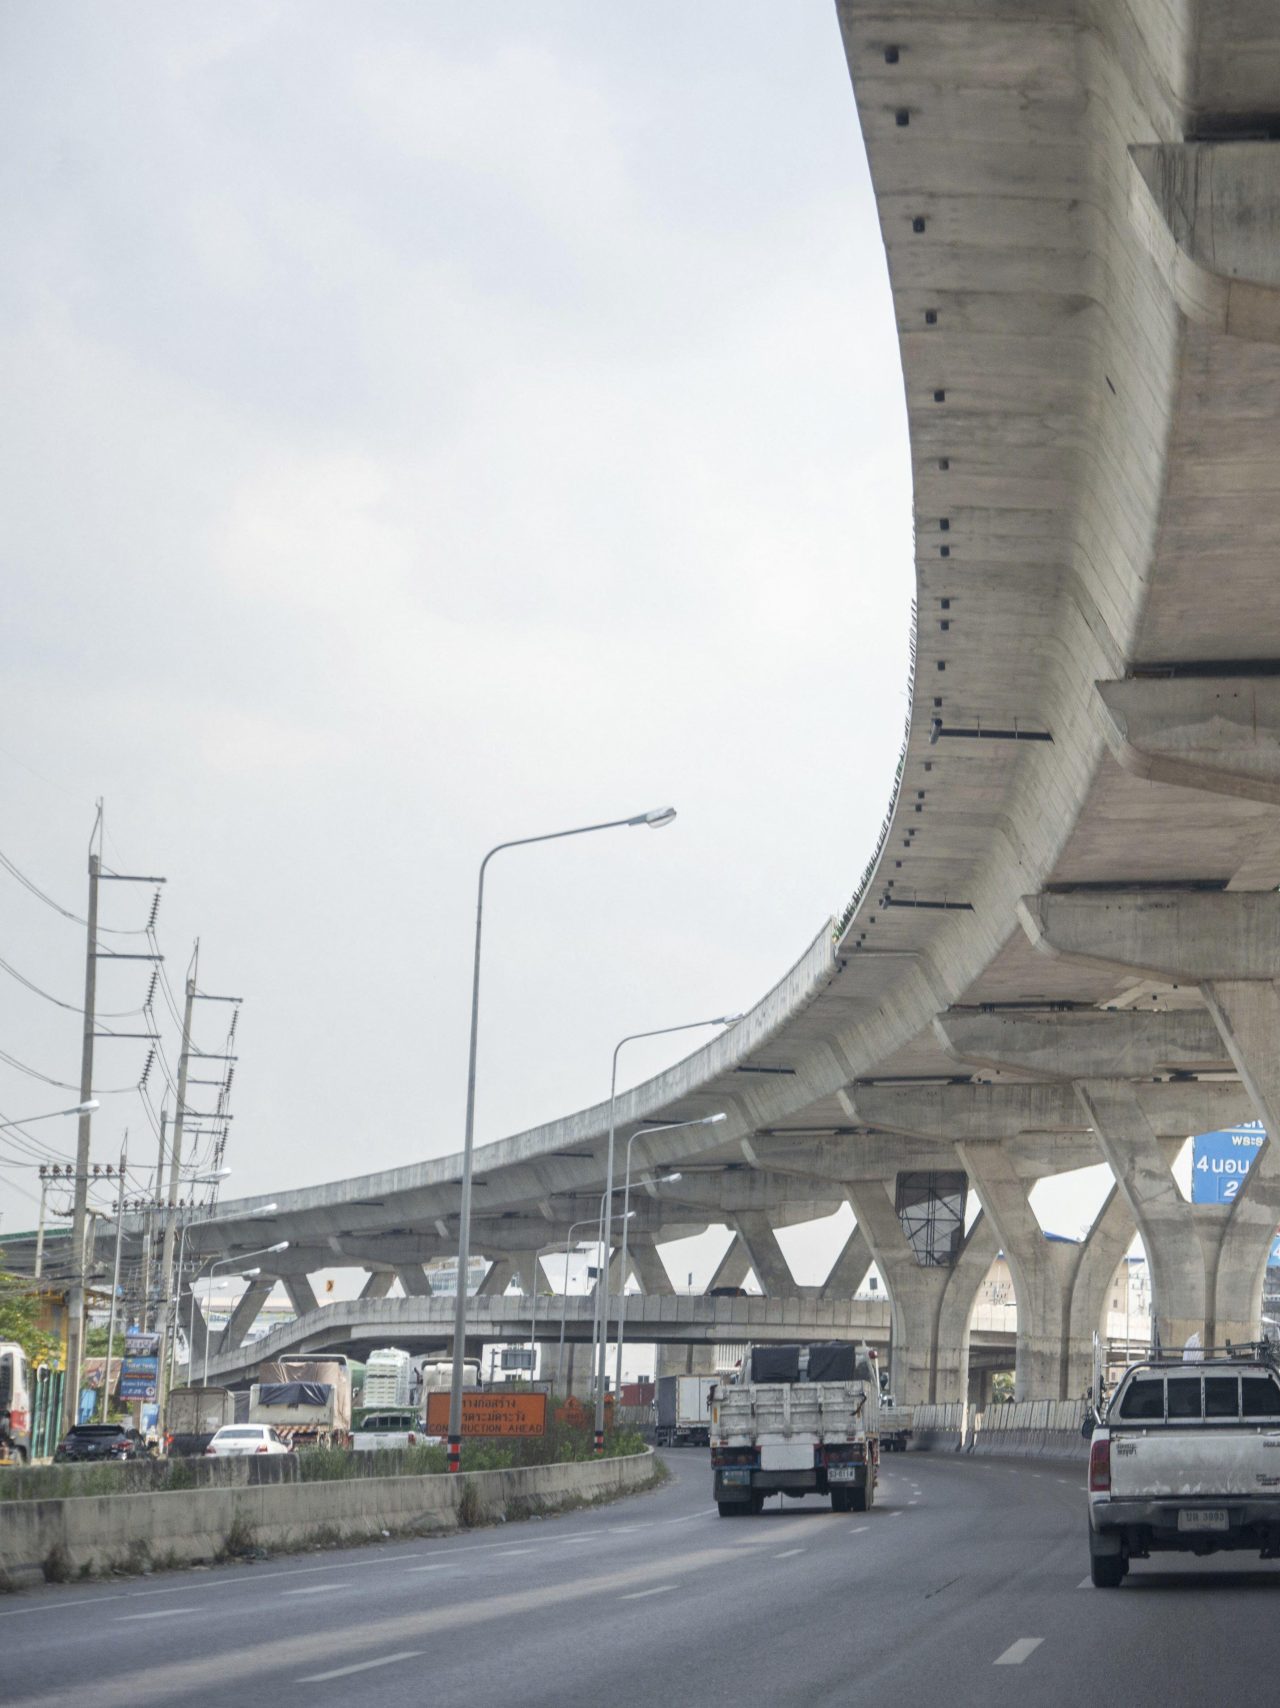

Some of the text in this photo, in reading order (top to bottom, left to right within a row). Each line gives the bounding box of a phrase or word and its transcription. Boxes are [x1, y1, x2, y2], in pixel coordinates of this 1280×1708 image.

[1197, 1155, 1209, 1173] 4
[1223, 1180, 1239, 1197] 2
[429, 1424, 543, 1433] CONRUCTION AHEAD
